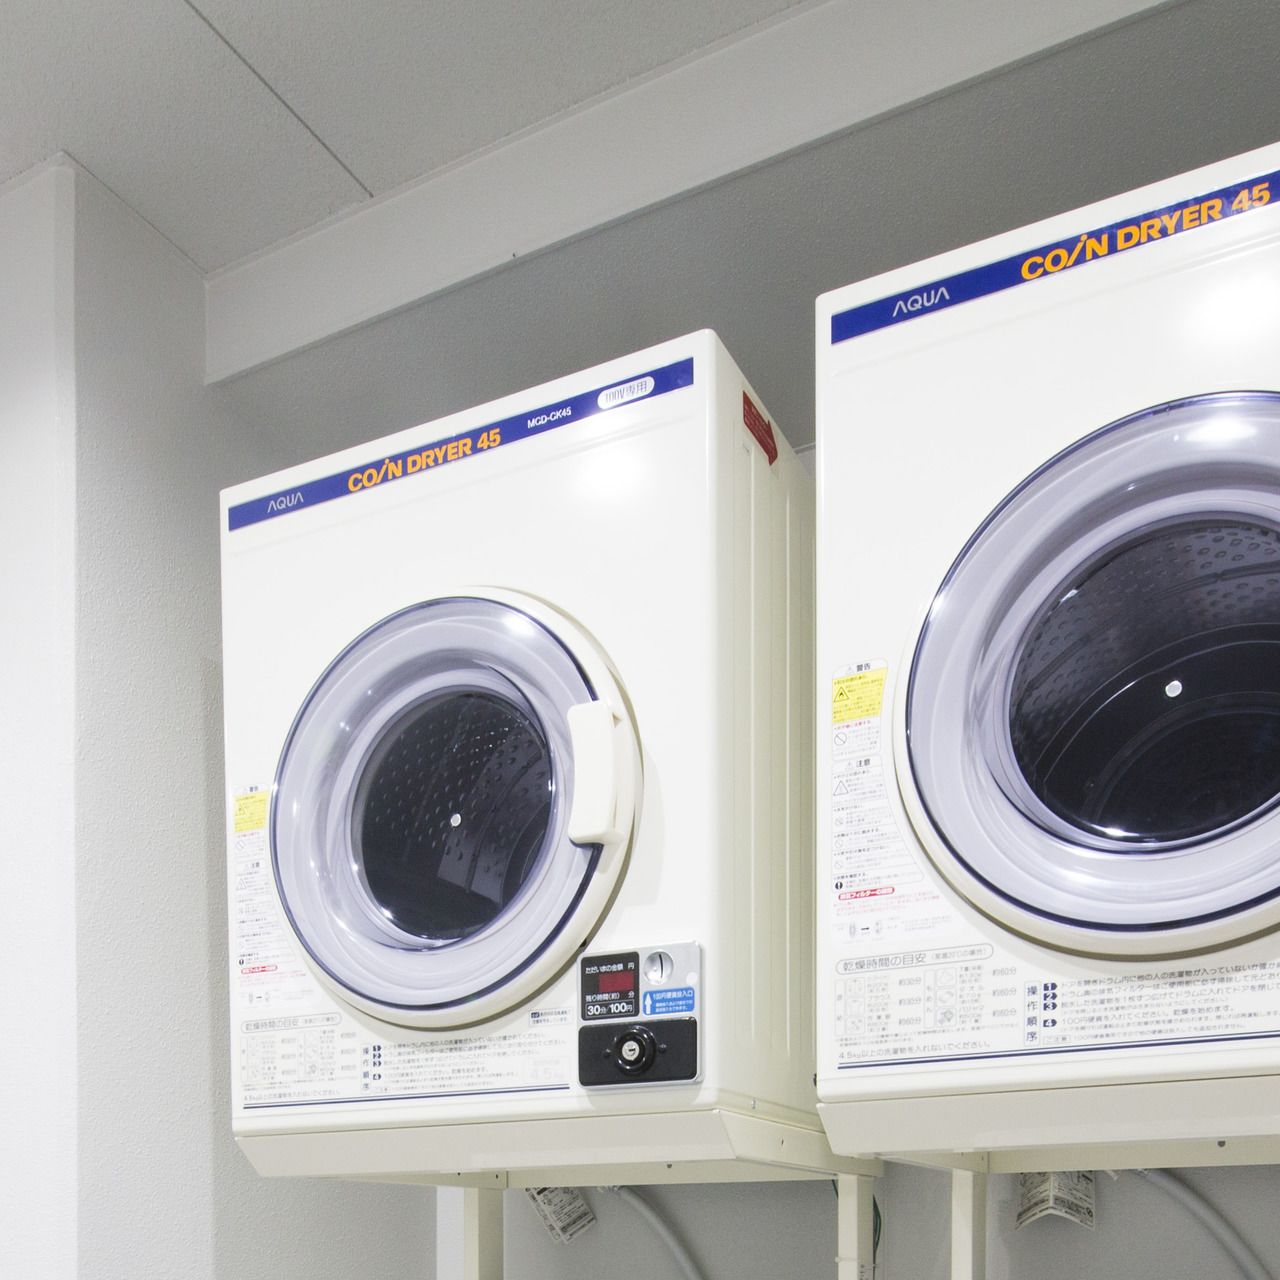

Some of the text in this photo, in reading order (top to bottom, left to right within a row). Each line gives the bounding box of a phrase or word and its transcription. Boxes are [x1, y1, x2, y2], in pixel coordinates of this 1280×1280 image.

[1116, 201, 1222, 252] DRYER
[1231, 183, 1271, 212] 45
[892, 286, 950, 318] AQUA
[527, 407, 572, 429] MCD-CK45
[406, 438, 472, 476] DRYER
[476, 428, 501, 450] 45
[267, 492, 304, 513] AQUA
